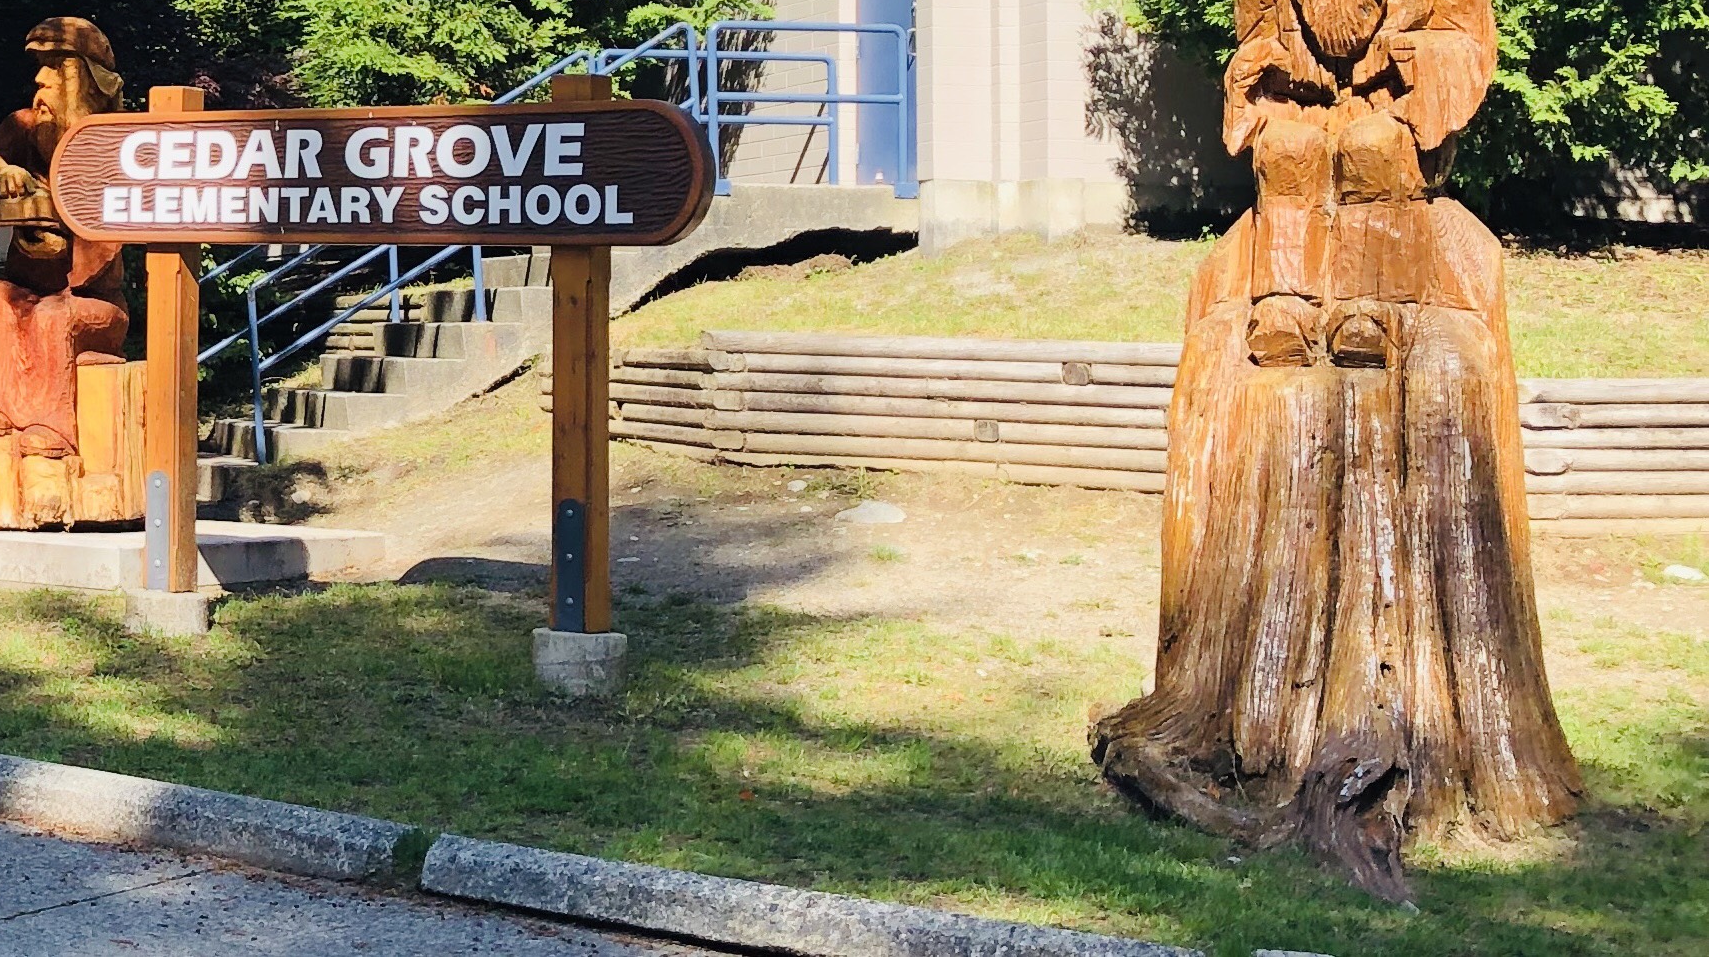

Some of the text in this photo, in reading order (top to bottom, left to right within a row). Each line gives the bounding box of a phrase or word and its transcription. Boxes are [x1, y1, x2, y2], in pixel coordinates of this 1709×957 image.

[119, 122, 585, 180] CEDAR GROVE
[103, 184, 634, 225] ELEMENTARY SCHOOL
